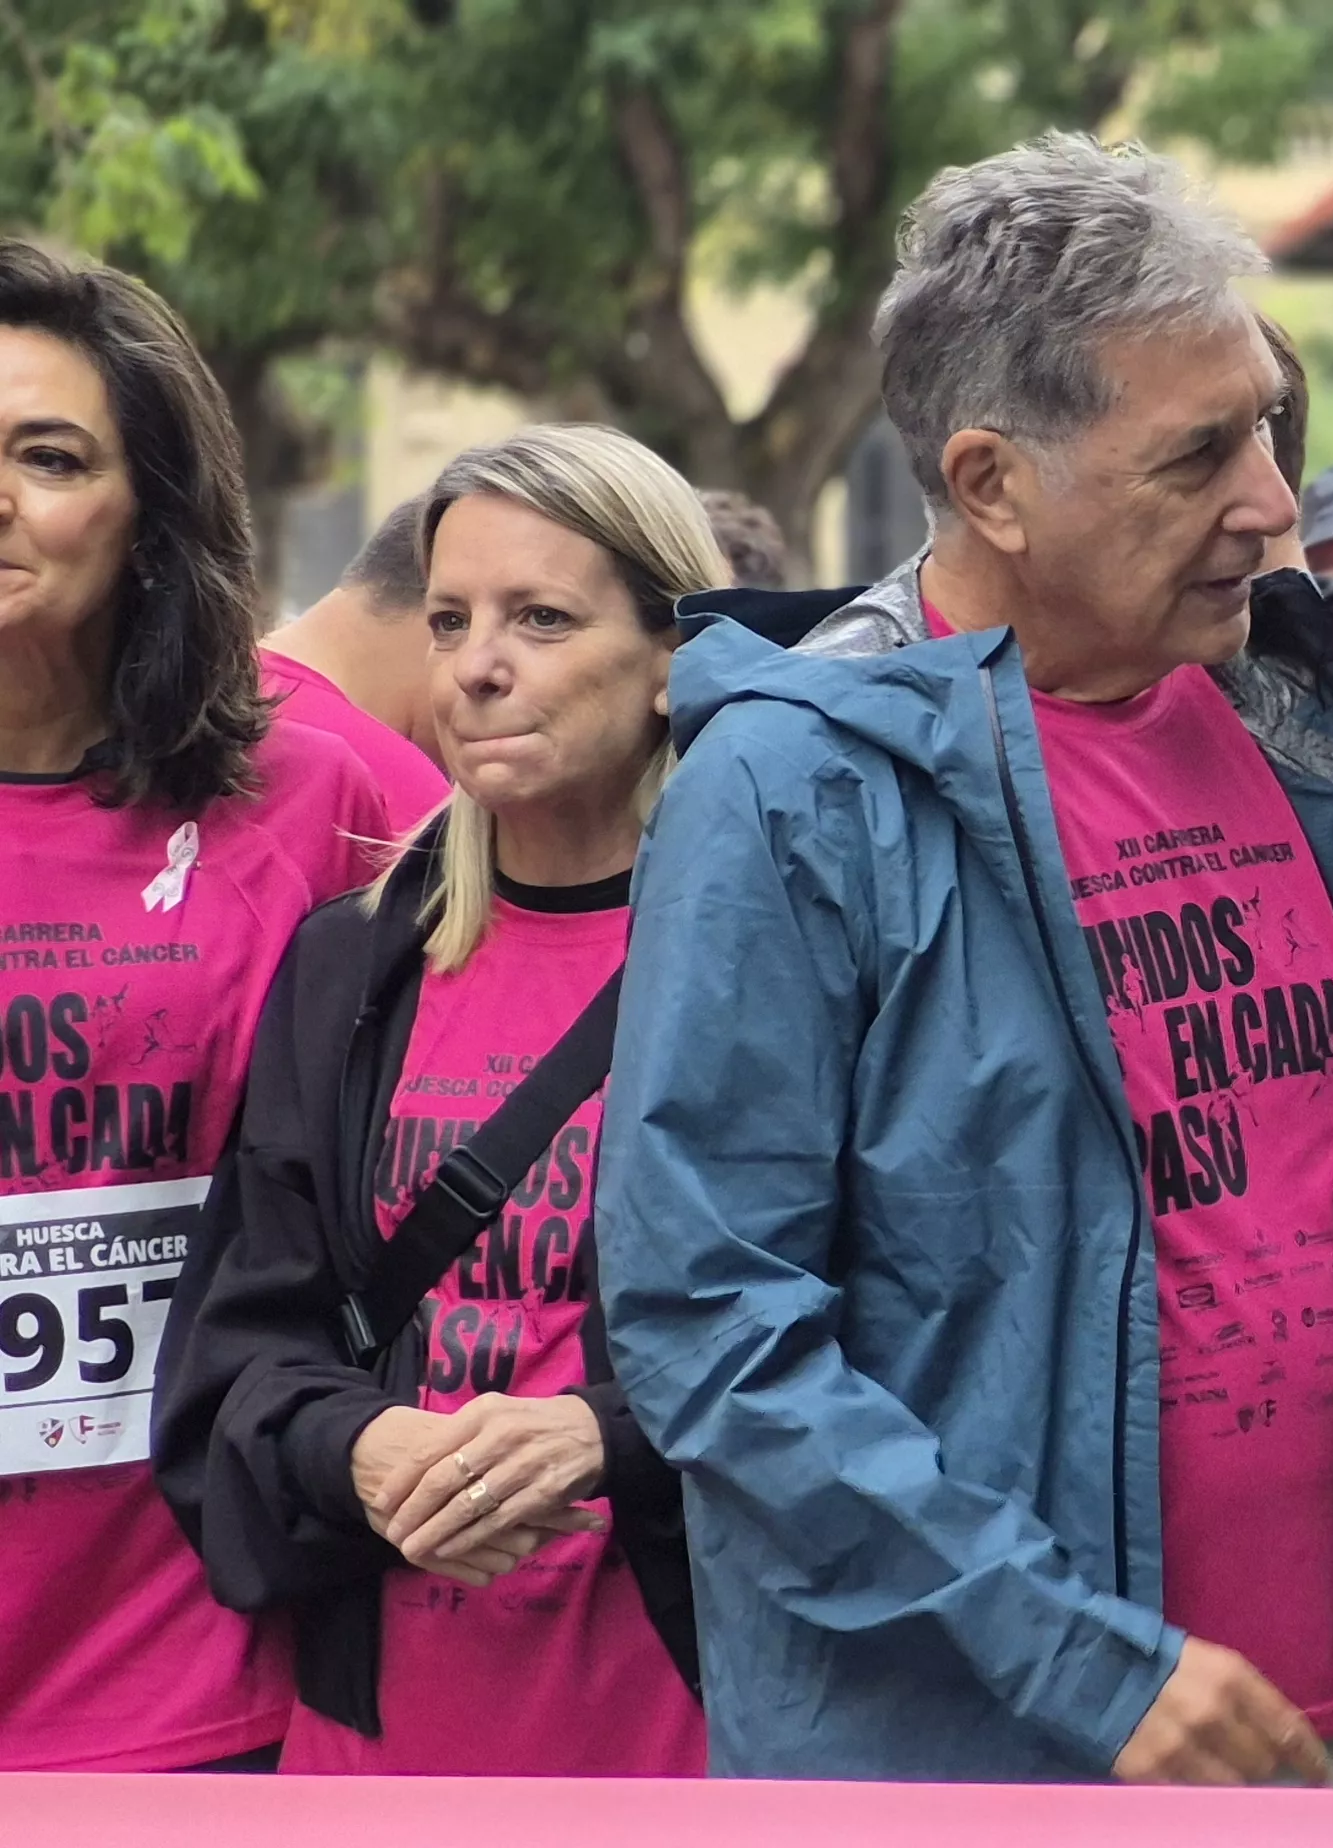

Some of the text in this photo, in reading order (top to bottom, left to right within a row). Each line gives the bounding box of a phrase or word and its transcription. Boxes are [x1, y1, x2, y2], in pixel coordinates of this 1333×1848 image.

[1115, 839, 1142, 861] XII
[64, 949, 95, 969] EL
[101, 942, 200, 967] CÁNCER
[0, 991, 90, 1084] OS
[1164, 996, 1234, 1100] EN
[15, 1221, 106, 1247] HUESCA
[49, 1246, 84, 1273] EL
[90, 1235, 189, 1268] CÁNCER
